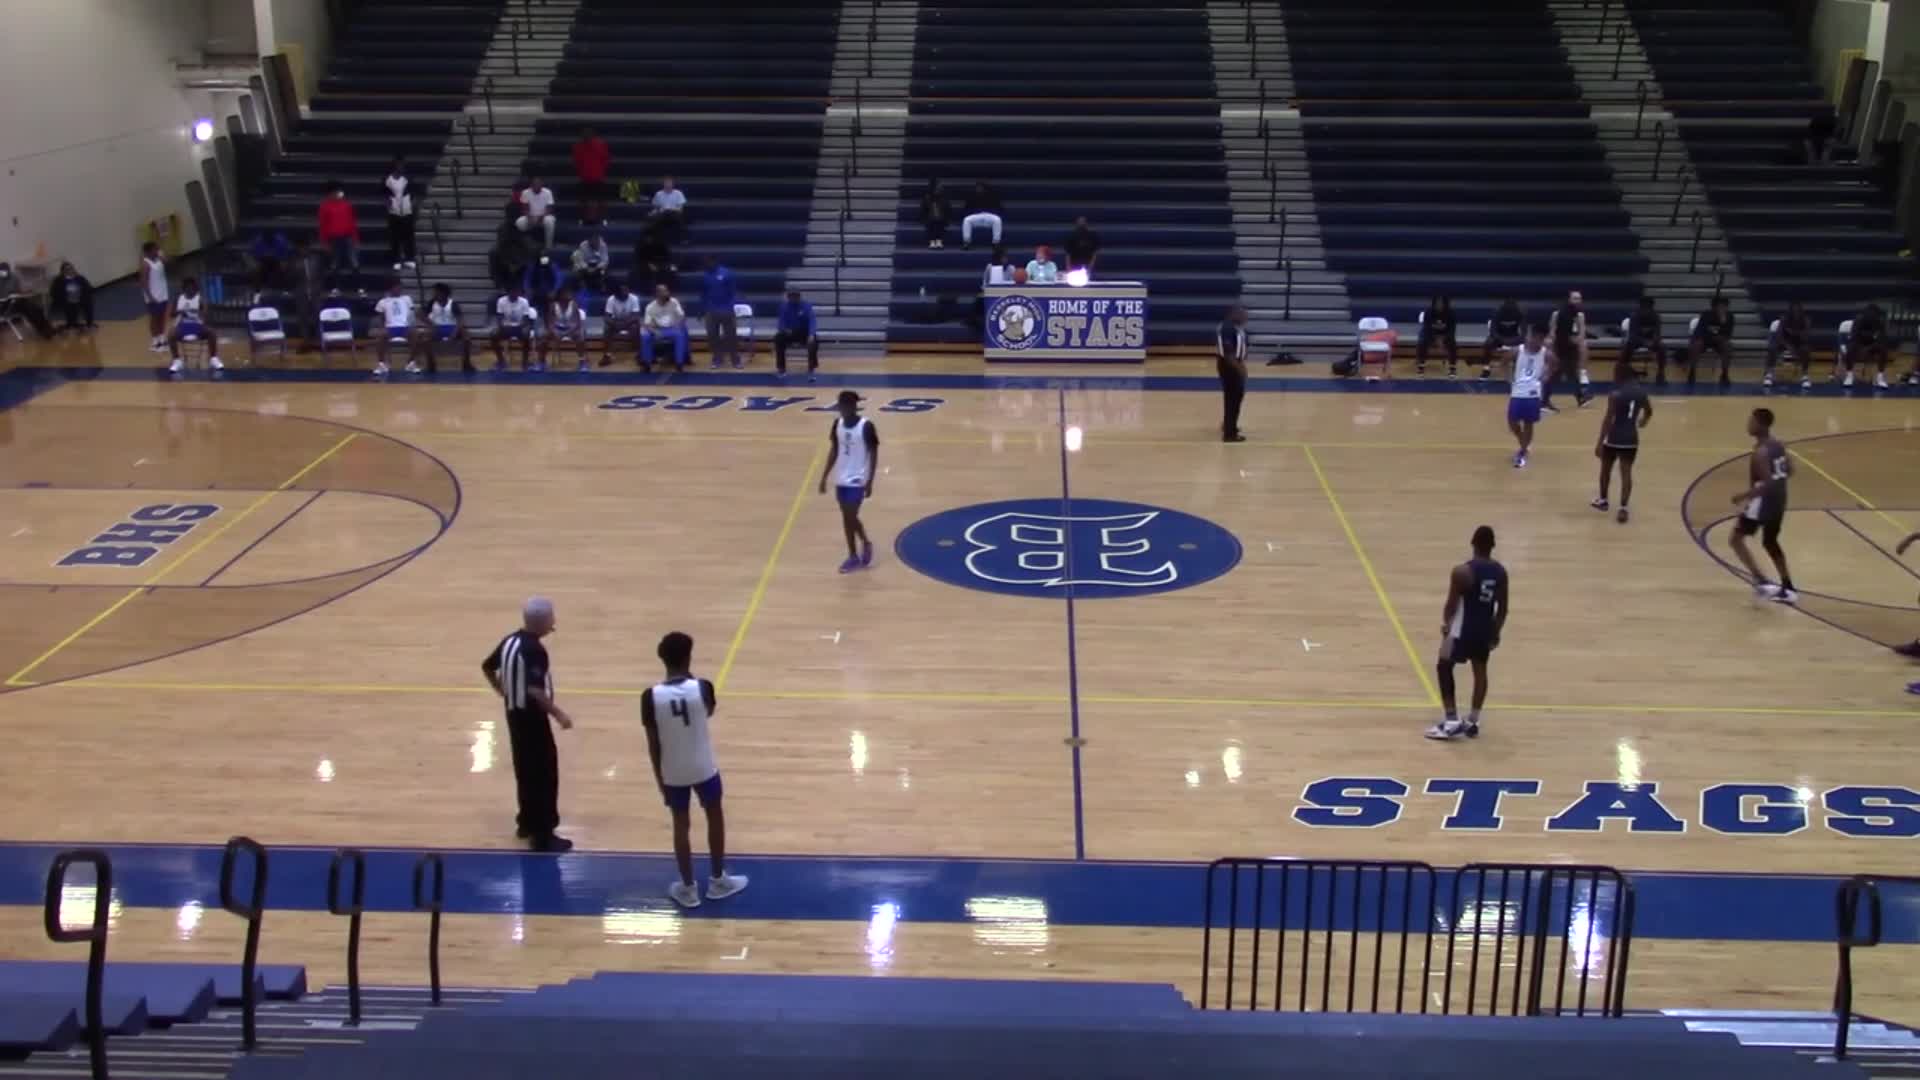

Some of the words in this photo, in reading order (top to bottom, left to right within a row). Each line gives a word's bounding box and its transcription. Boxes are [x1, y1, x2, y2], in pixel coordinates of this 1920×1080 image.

[1048, 300, 1088, 314] HOME
[1093, 300, 1110, 314] OF
[1115, 300, 1143, 314] THE
[1047, 316, 1143, 347] STAGS
[51, 503, 222, 567] BHS
[1479, 579, 1497, 602] 5
[669, 698, 690, 727] 4
[1292, 777, 1920, 837] STAGS
